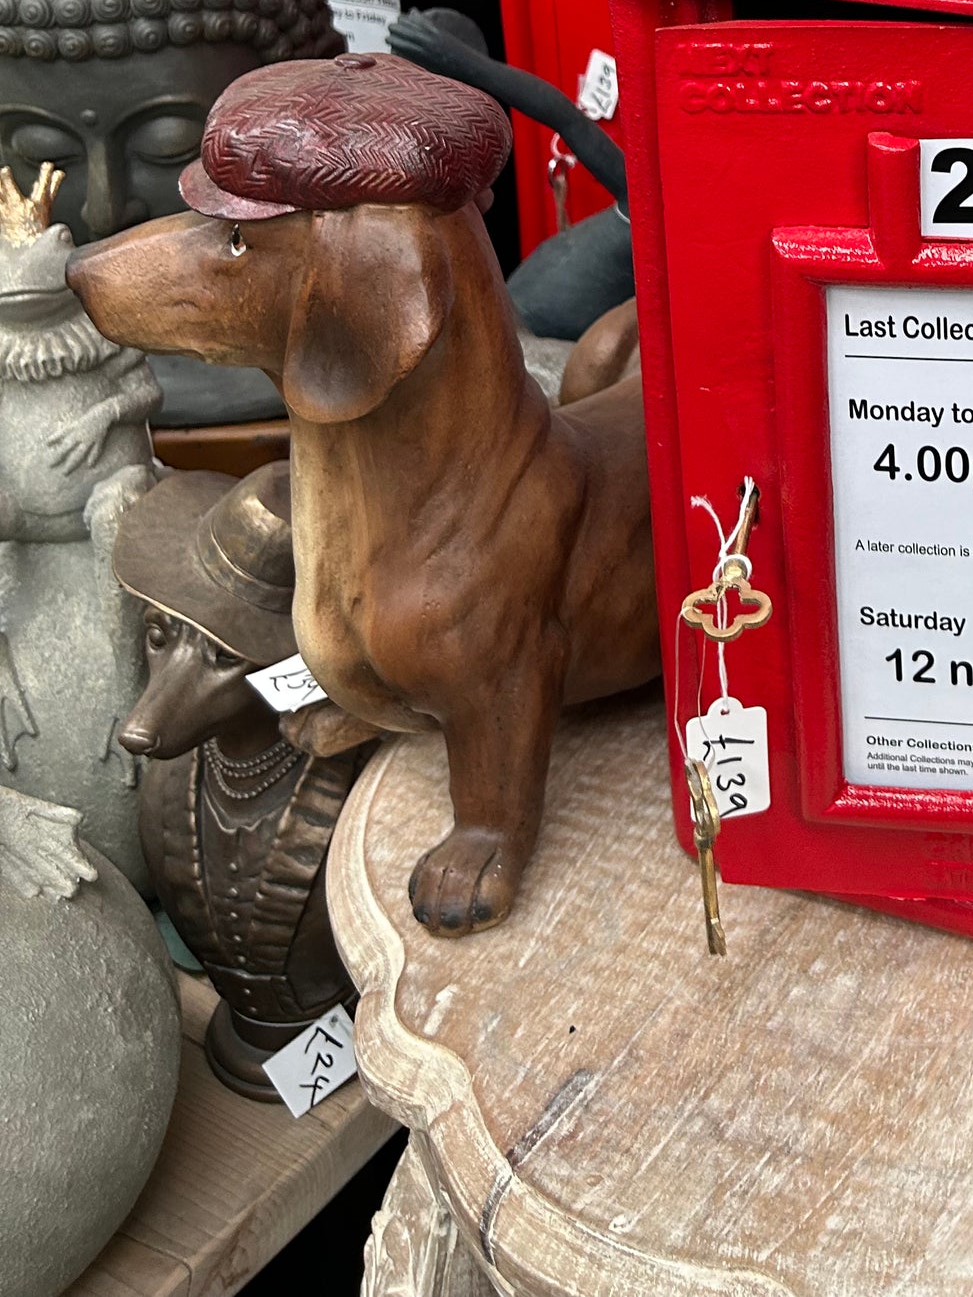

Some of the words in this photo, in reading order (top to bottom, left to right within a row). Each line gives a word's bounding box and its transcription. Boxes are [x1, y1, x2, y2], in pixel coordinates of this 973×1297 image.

[679, 79, 922, 115] COLLECTION
[845, 314, 897, 338] Last
[849, 399, 944, 428] Monday
[855, 539, 865, 551] A
[867, 540, 894, 553] later
[898, 543, 956, 557] collection
[960, 545, 970, 558] is
[860, 606, 966, 637] Saturday
[885, 648, 936, 684] 12
[866, 735, 903, 748] Other
[867, 751, 908, 762] Additional
[910, 754, 956, 765] Collections
[867, 762, 885, 770] until
[902, 764, 917, 772] last
[919, 766, 936, 774] time
[939, 766, 968, 776] shown.
[703, 734, 755, 818] £139
[298, 1026, 344, 1108] £24
